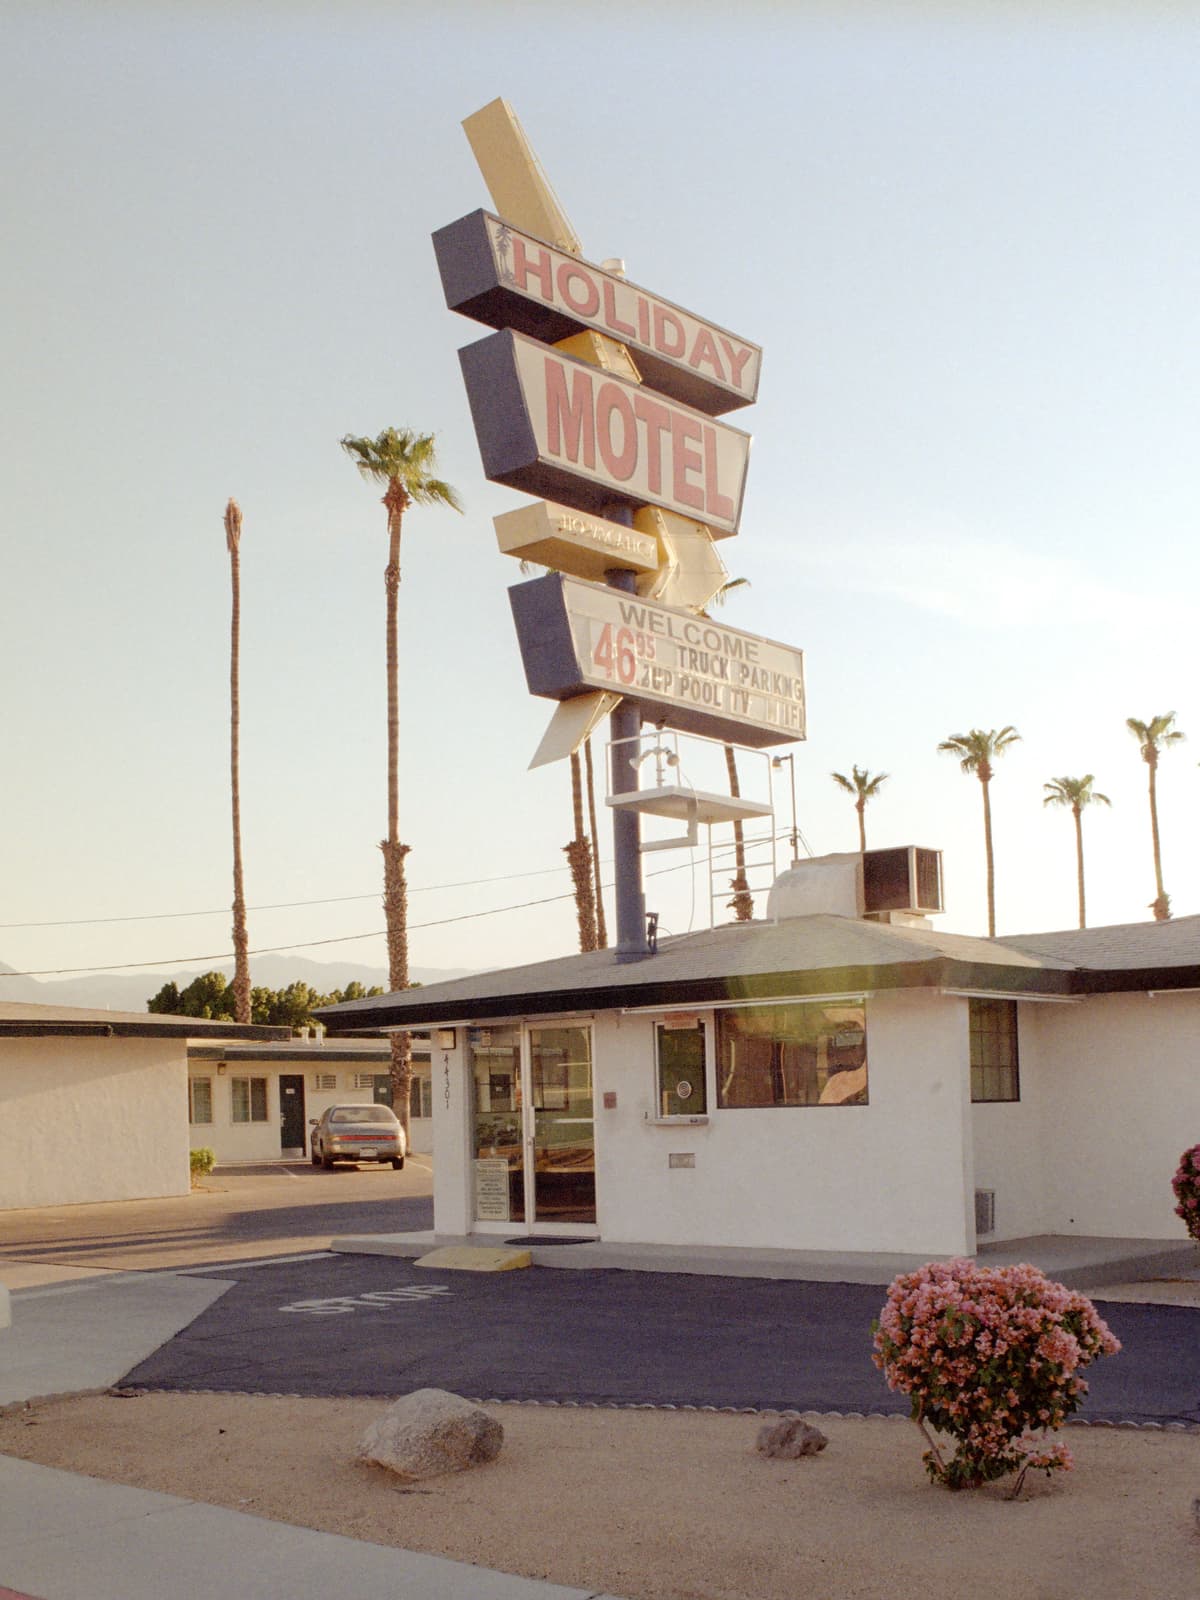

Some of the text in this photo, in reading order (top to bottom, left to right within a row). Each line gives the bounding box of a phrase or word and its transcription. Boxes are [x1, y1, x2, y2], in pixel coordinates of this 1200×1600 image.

[511, 236, 752, 389] HOLIDAY
[544, 356, 735, 522] MOTEL
[618, 601, 760, 664] WELCOME
[678, 645, 729, 680] TRUCK
[680, 674, 722, 707] POOL
[730, 687, 750, 714] TV
[278, 1284, 456, 1314] STOP
